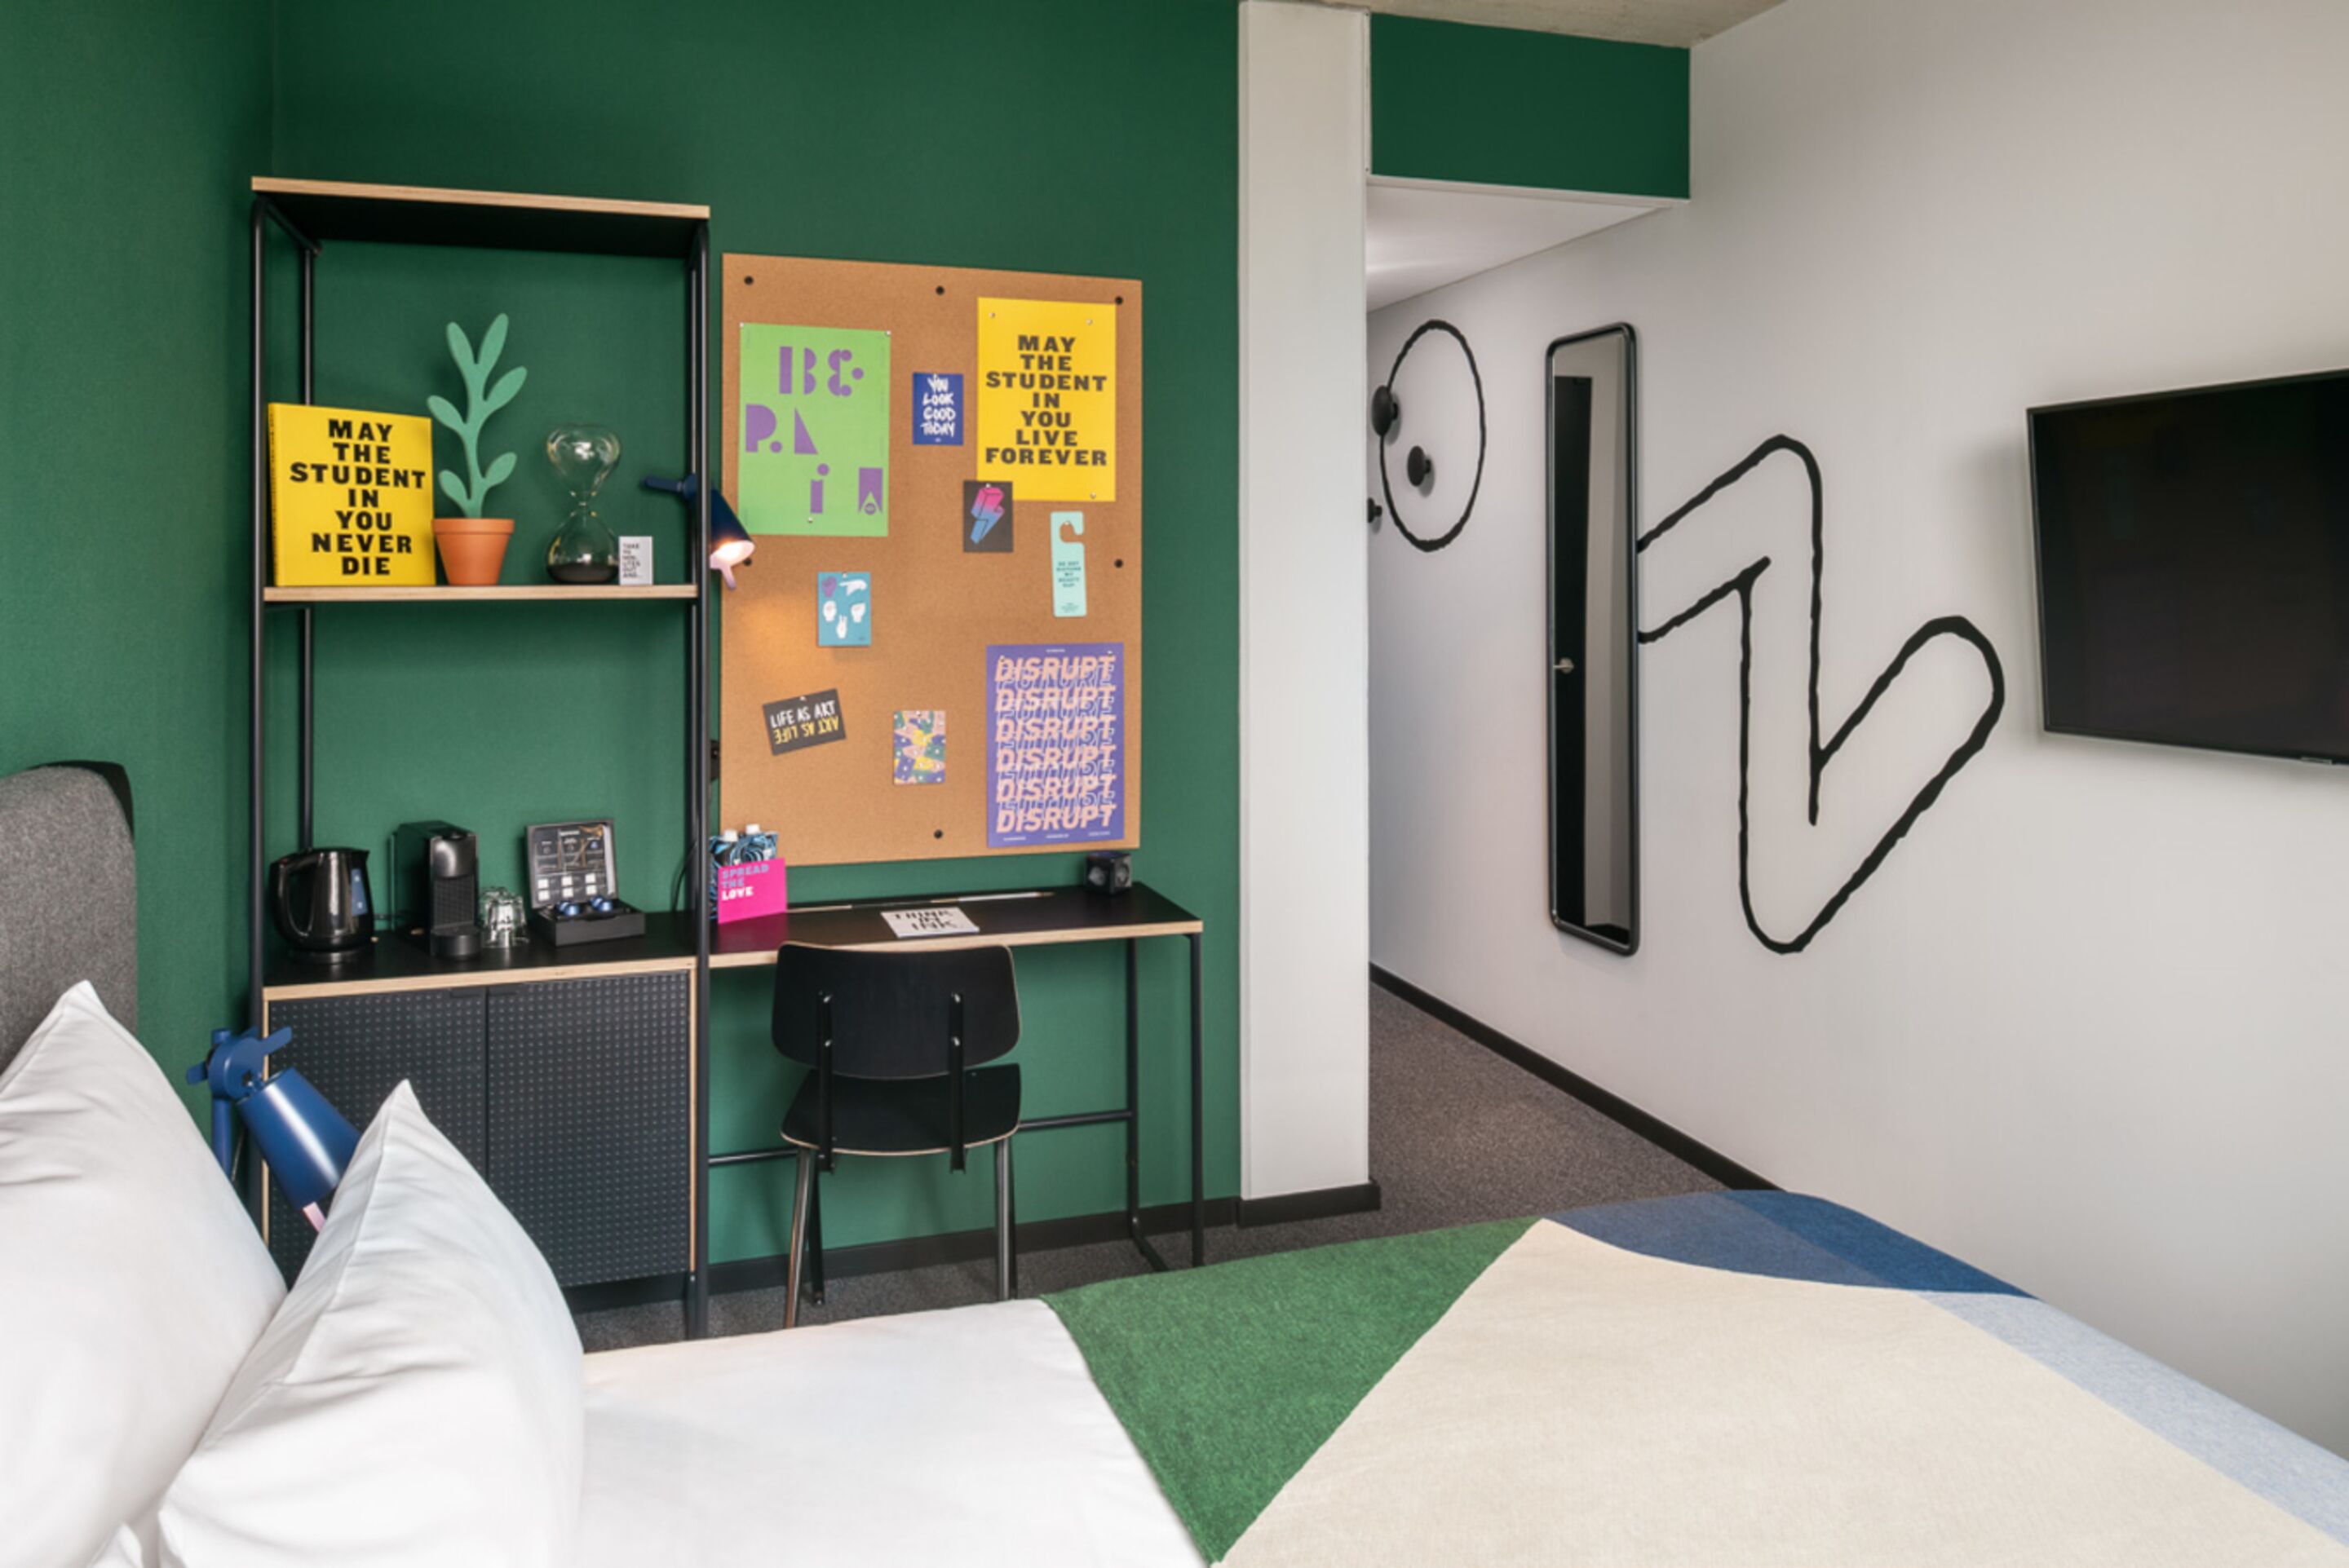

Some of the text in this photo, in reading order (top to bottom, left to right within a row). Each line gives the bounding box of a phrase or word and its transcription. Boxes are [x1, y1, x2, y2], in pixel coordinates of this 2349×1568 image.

[1018, 334, 1076, 352] MAY
[1020, 354, 1072, 371] THE
[985, 371, 1108, 391] STUDENT
[922, 392, 954, 406] LOOK
[1033, 392, 1060, 409] IN
[923, 406, 956, 421] GOOD
[1020, 411, 1071, 427] YOU
[329, 418, 393, 442] MAY
[920, 421, 955, 438] TODAY
[1016, 429, 1077, 447] LIVE
[333, 442, 391, 464] THE
[985, 447, 1108, 466] FOREVER
[290, 462, 426, 489] STUDENT
[348, 488, 378, 507] IN
[335, 510, 392, 531] YOU
[312, 532, 412, 554] NEVER
[342, 556, 391, 576] DIE
[995, 656, 1116, 682] DISRUPT
[996, 685, 1116, 712] DISRUPT
[770, 700, 835, 728] LIFE AS ART
[774, 724, 798, 744] LIFE
[818, 716, 839, 735] ART
[996, 714, 1117, 742] DISRUPT
[996, 744, 1117, 773] DISRUPT
[996, 774, 1117, 803] DISRUPT
[996, 804, 1117, 833] DISRUPT
[722, 864, 769, 879] SPREAD
[722, 878, 744, 890] THE
[722, 886, 754, 901] LOVE
